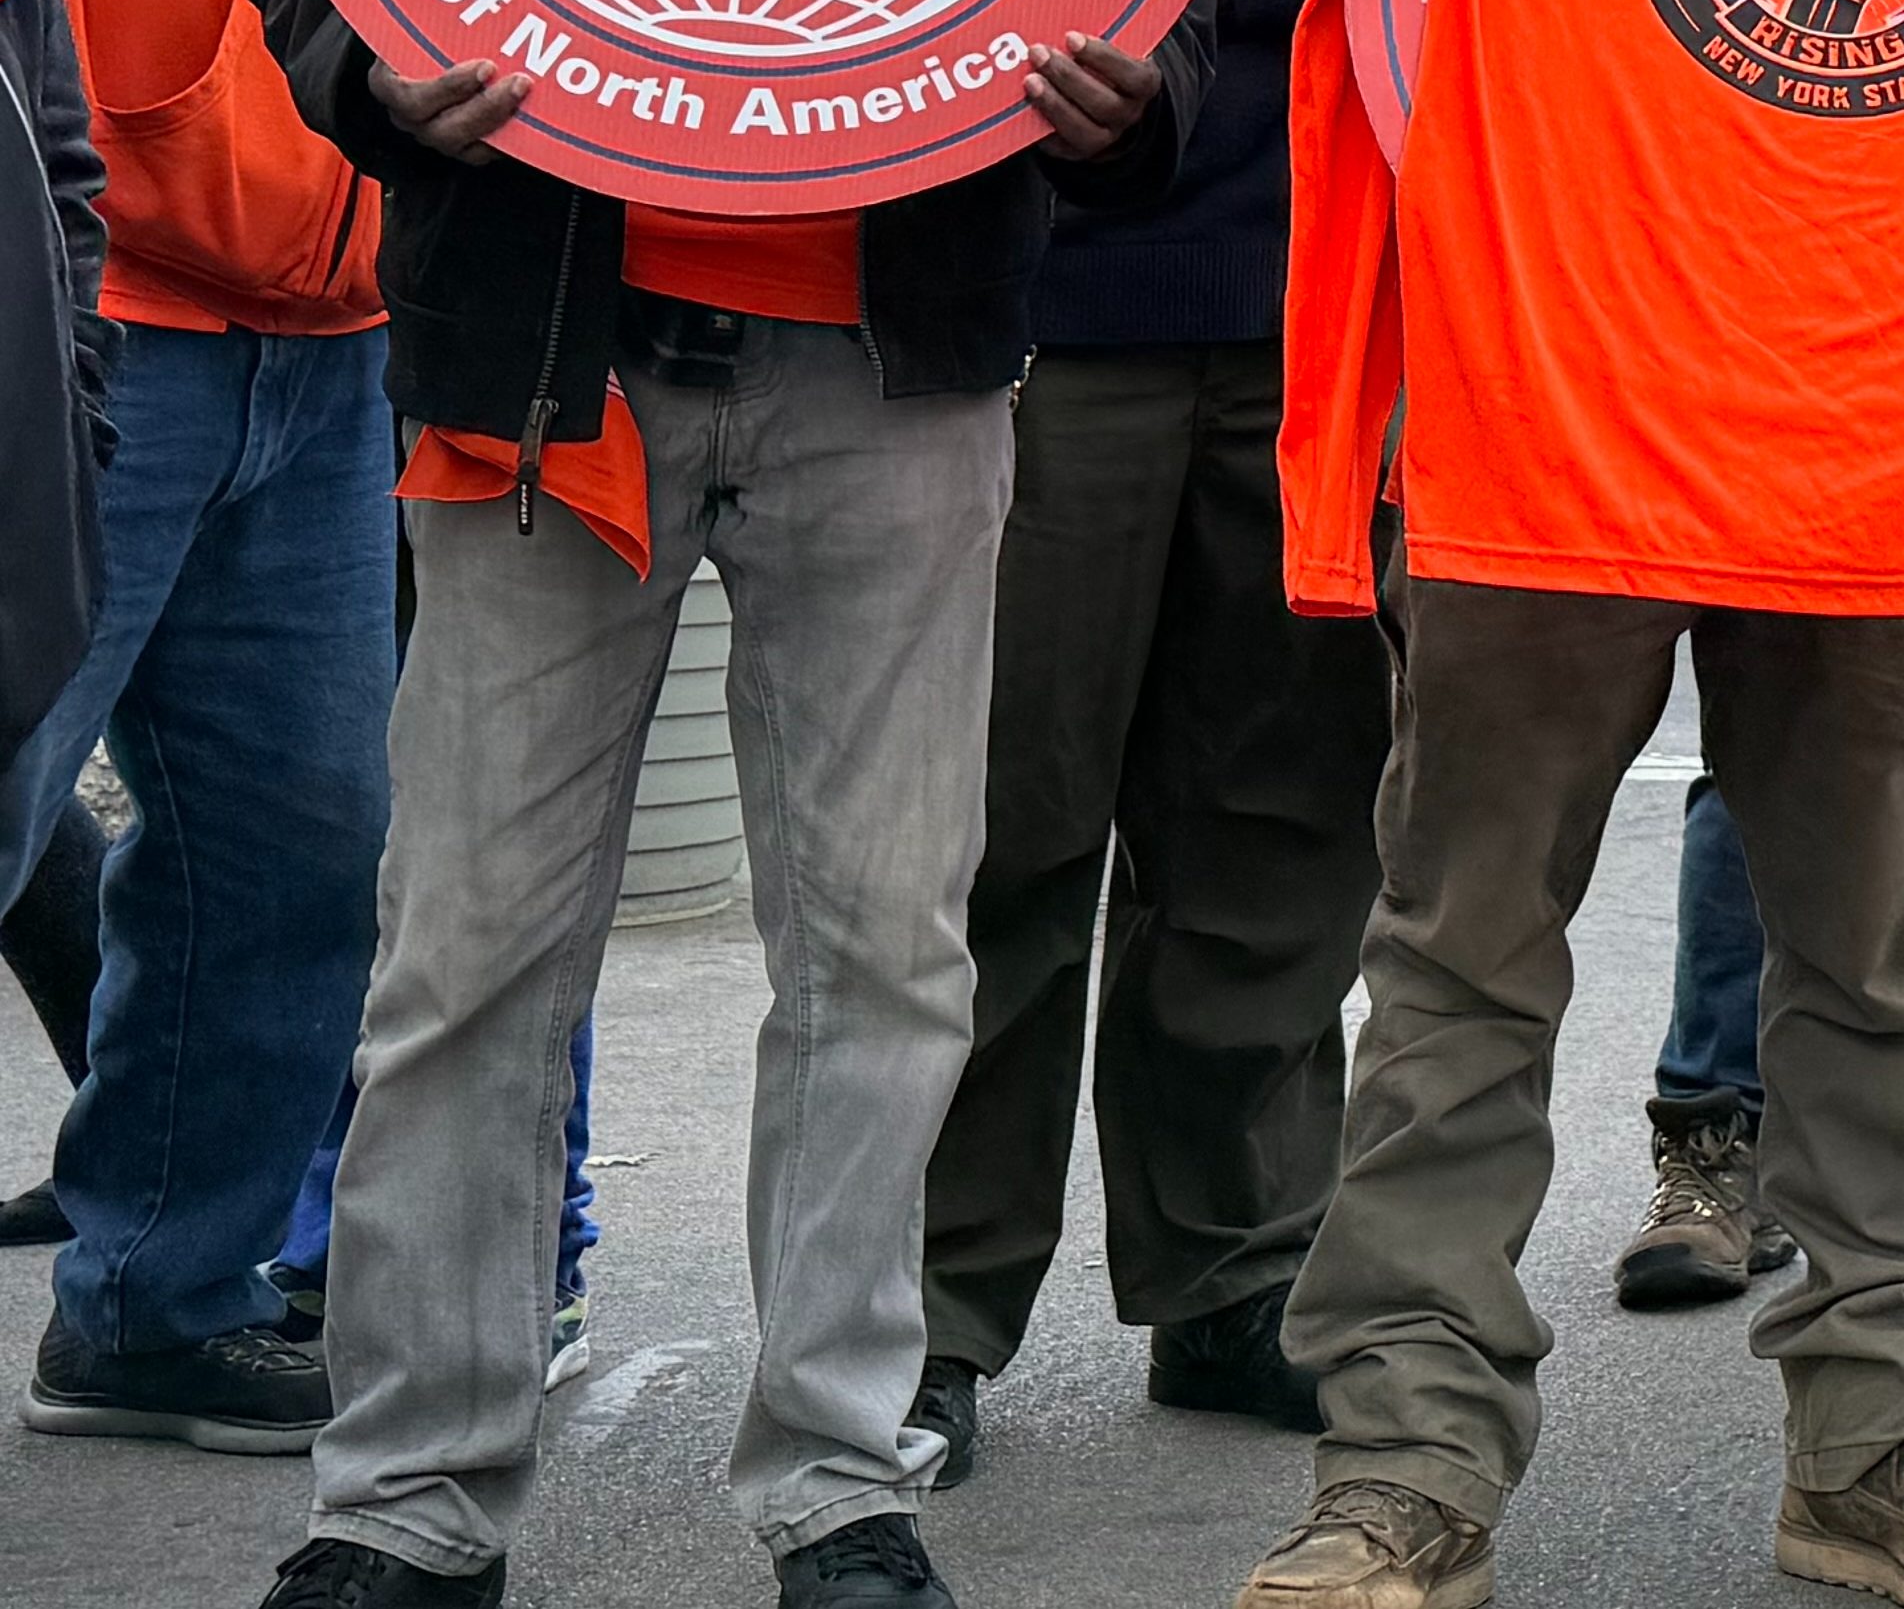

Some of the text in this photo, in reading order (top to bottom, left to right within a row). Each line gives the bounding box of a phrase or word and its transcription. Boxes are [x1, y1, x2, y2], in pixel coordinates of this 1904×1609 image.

[499, 5, 706, 130] North
[729, 30, 1030, 137] America
[1702, 35, 1766, 87] NEW
[1776, 75, 1850, 110] YORK
